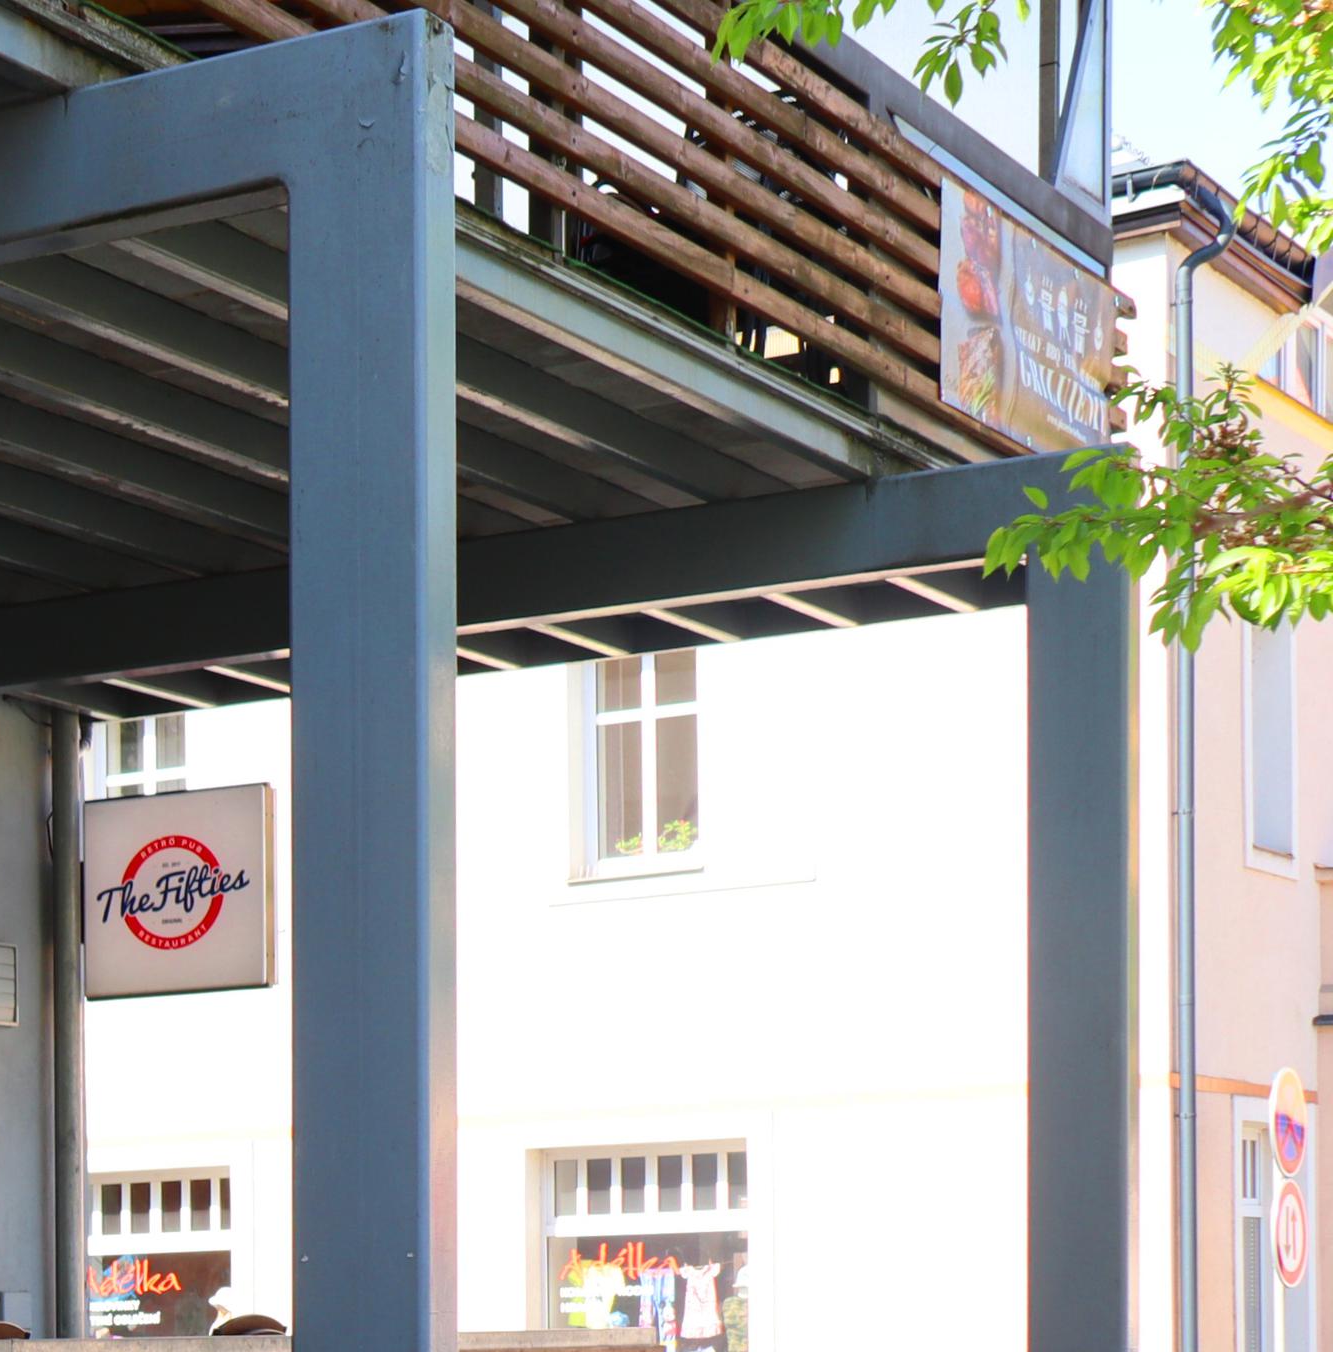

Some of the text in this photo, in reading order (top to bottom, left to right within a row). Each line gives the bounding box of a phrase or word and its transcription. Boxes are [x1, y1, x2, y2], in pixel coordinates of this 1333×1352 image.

[140, 836, 204, 860] RETRO PUB
[96, 864, 251, 924] The Fifties
[137, 923, 207, 949] RESTAURANT
